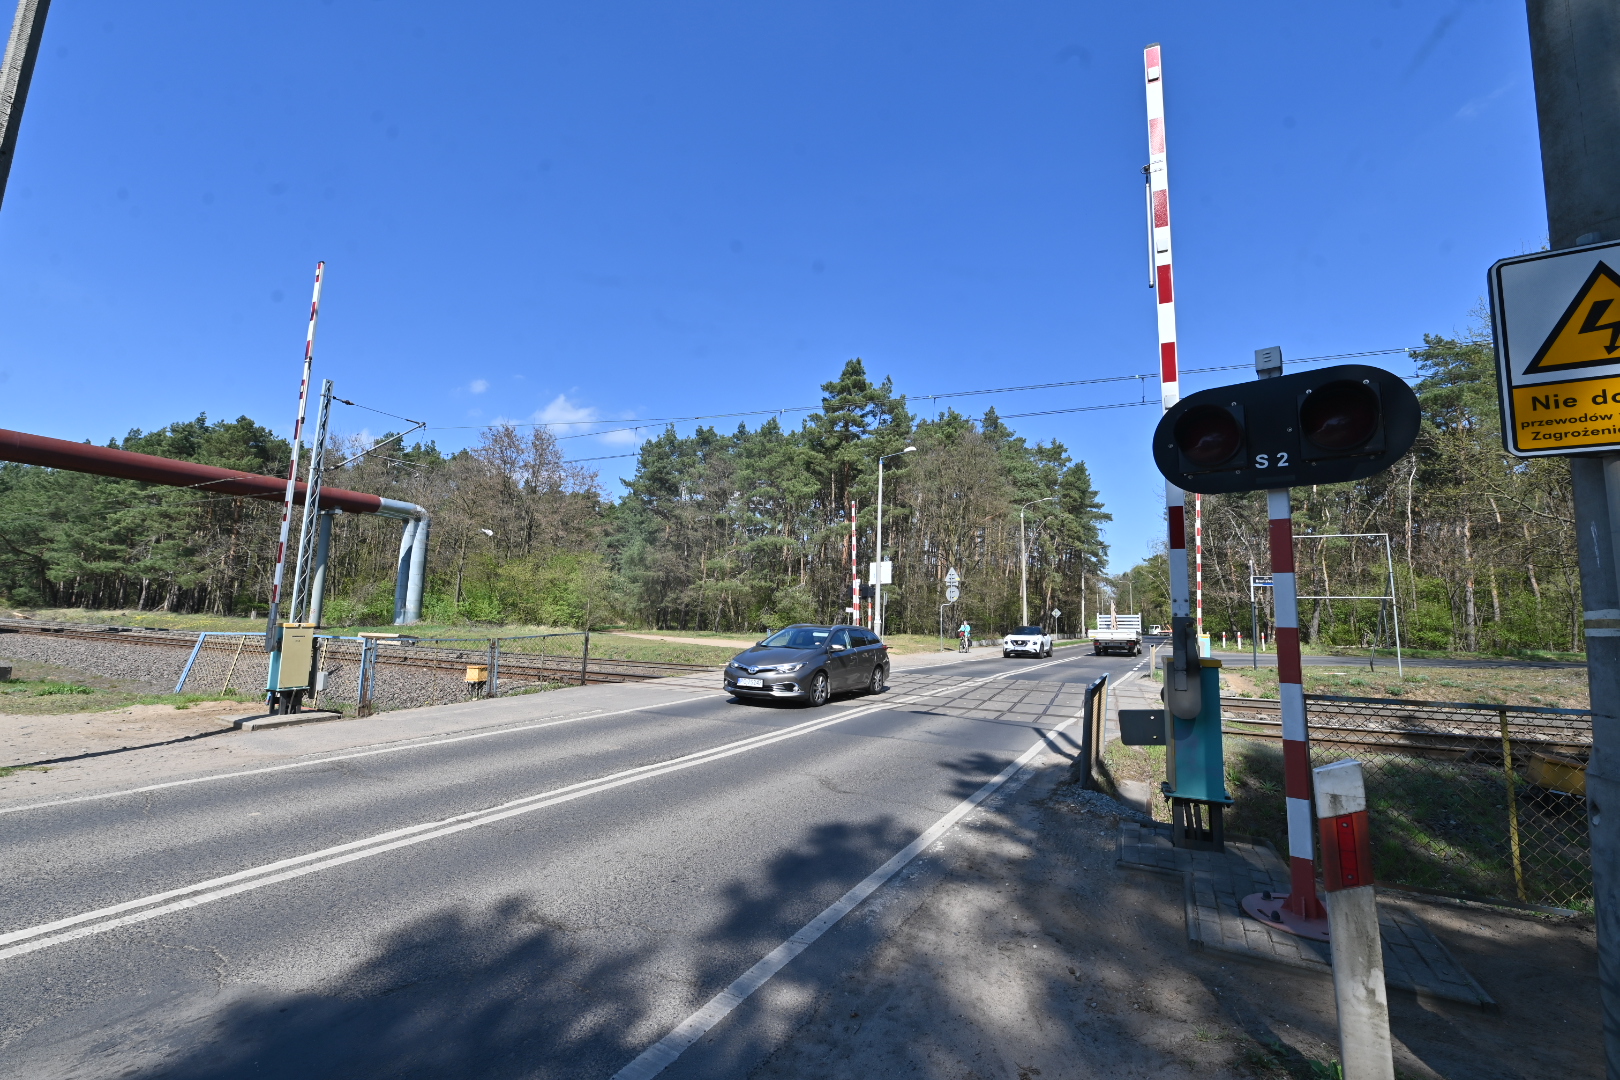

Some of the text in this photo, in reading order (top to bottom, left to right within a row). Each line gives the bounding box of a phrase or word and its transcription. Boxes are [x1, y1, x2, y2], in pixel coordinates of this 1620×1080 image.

[1531, 394, 1578, 411] Nie
[1521, 413, 1613, 430] przewodów
[1531, 425, 1620, 441] Zagrożeni
[1255, 451, 1289, 469] S 2
